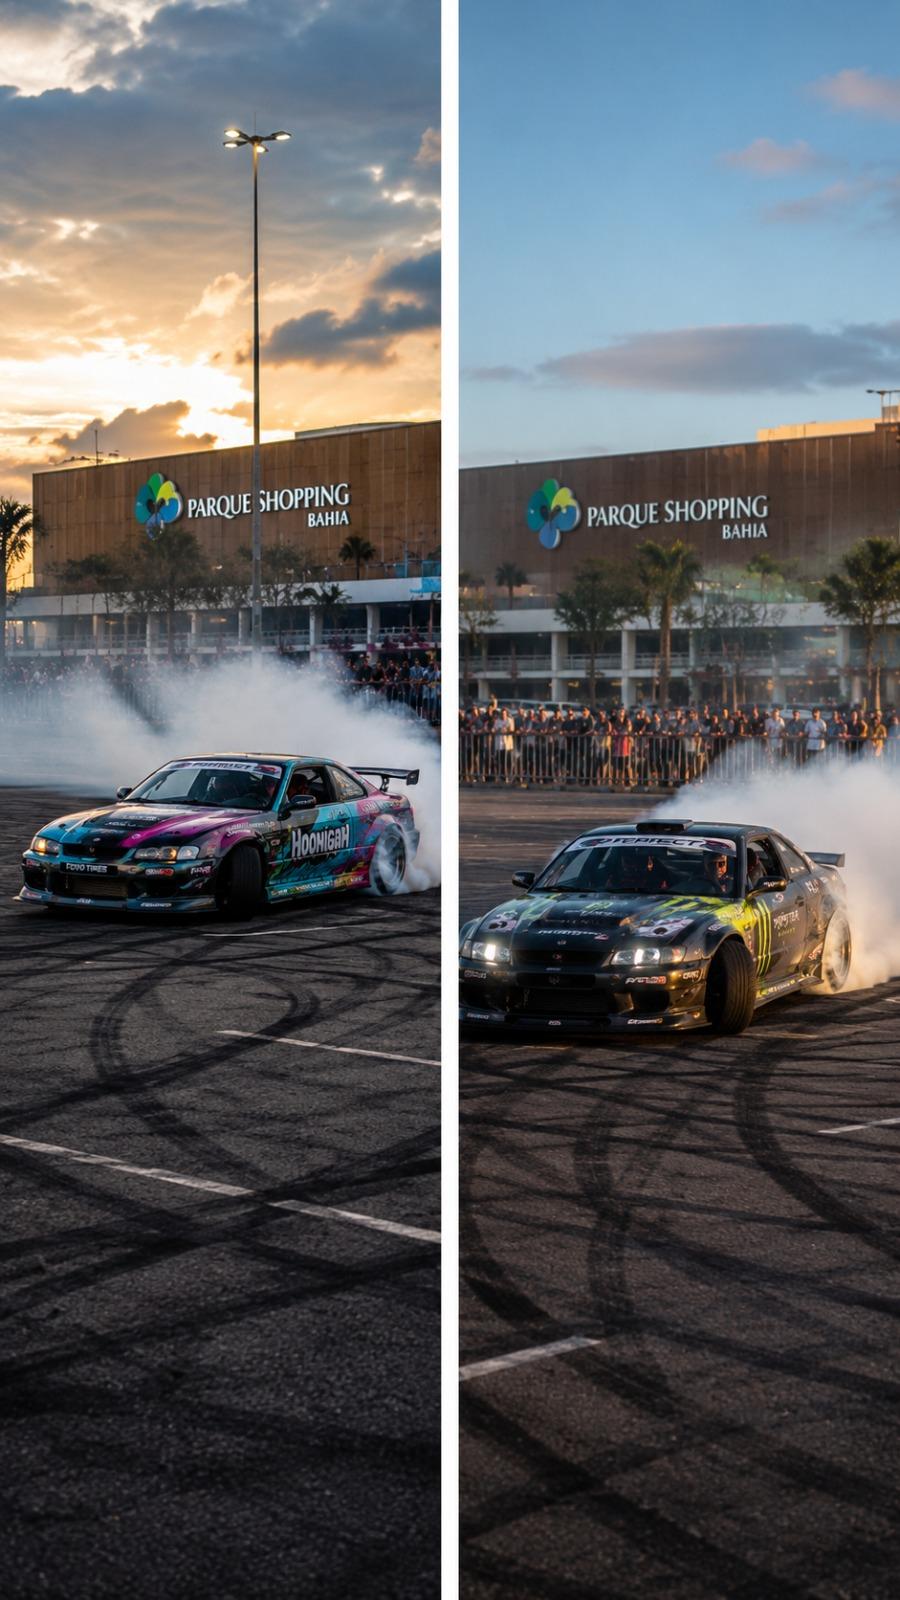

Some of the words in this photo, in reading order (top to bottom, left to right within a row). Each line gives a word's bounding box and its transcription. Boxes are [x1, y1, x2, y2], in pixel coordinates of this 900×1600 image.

[187, 493, 251, 519] PARQUE
[259, 483, 349, 513] SHOPPING
[587, 503, 659, 529] PARQUE
[664, 495, 768, 523] SHOPPING
[308, 510, 349, 528] BAHIA
[722, 522, 768, 540] BAHIA
